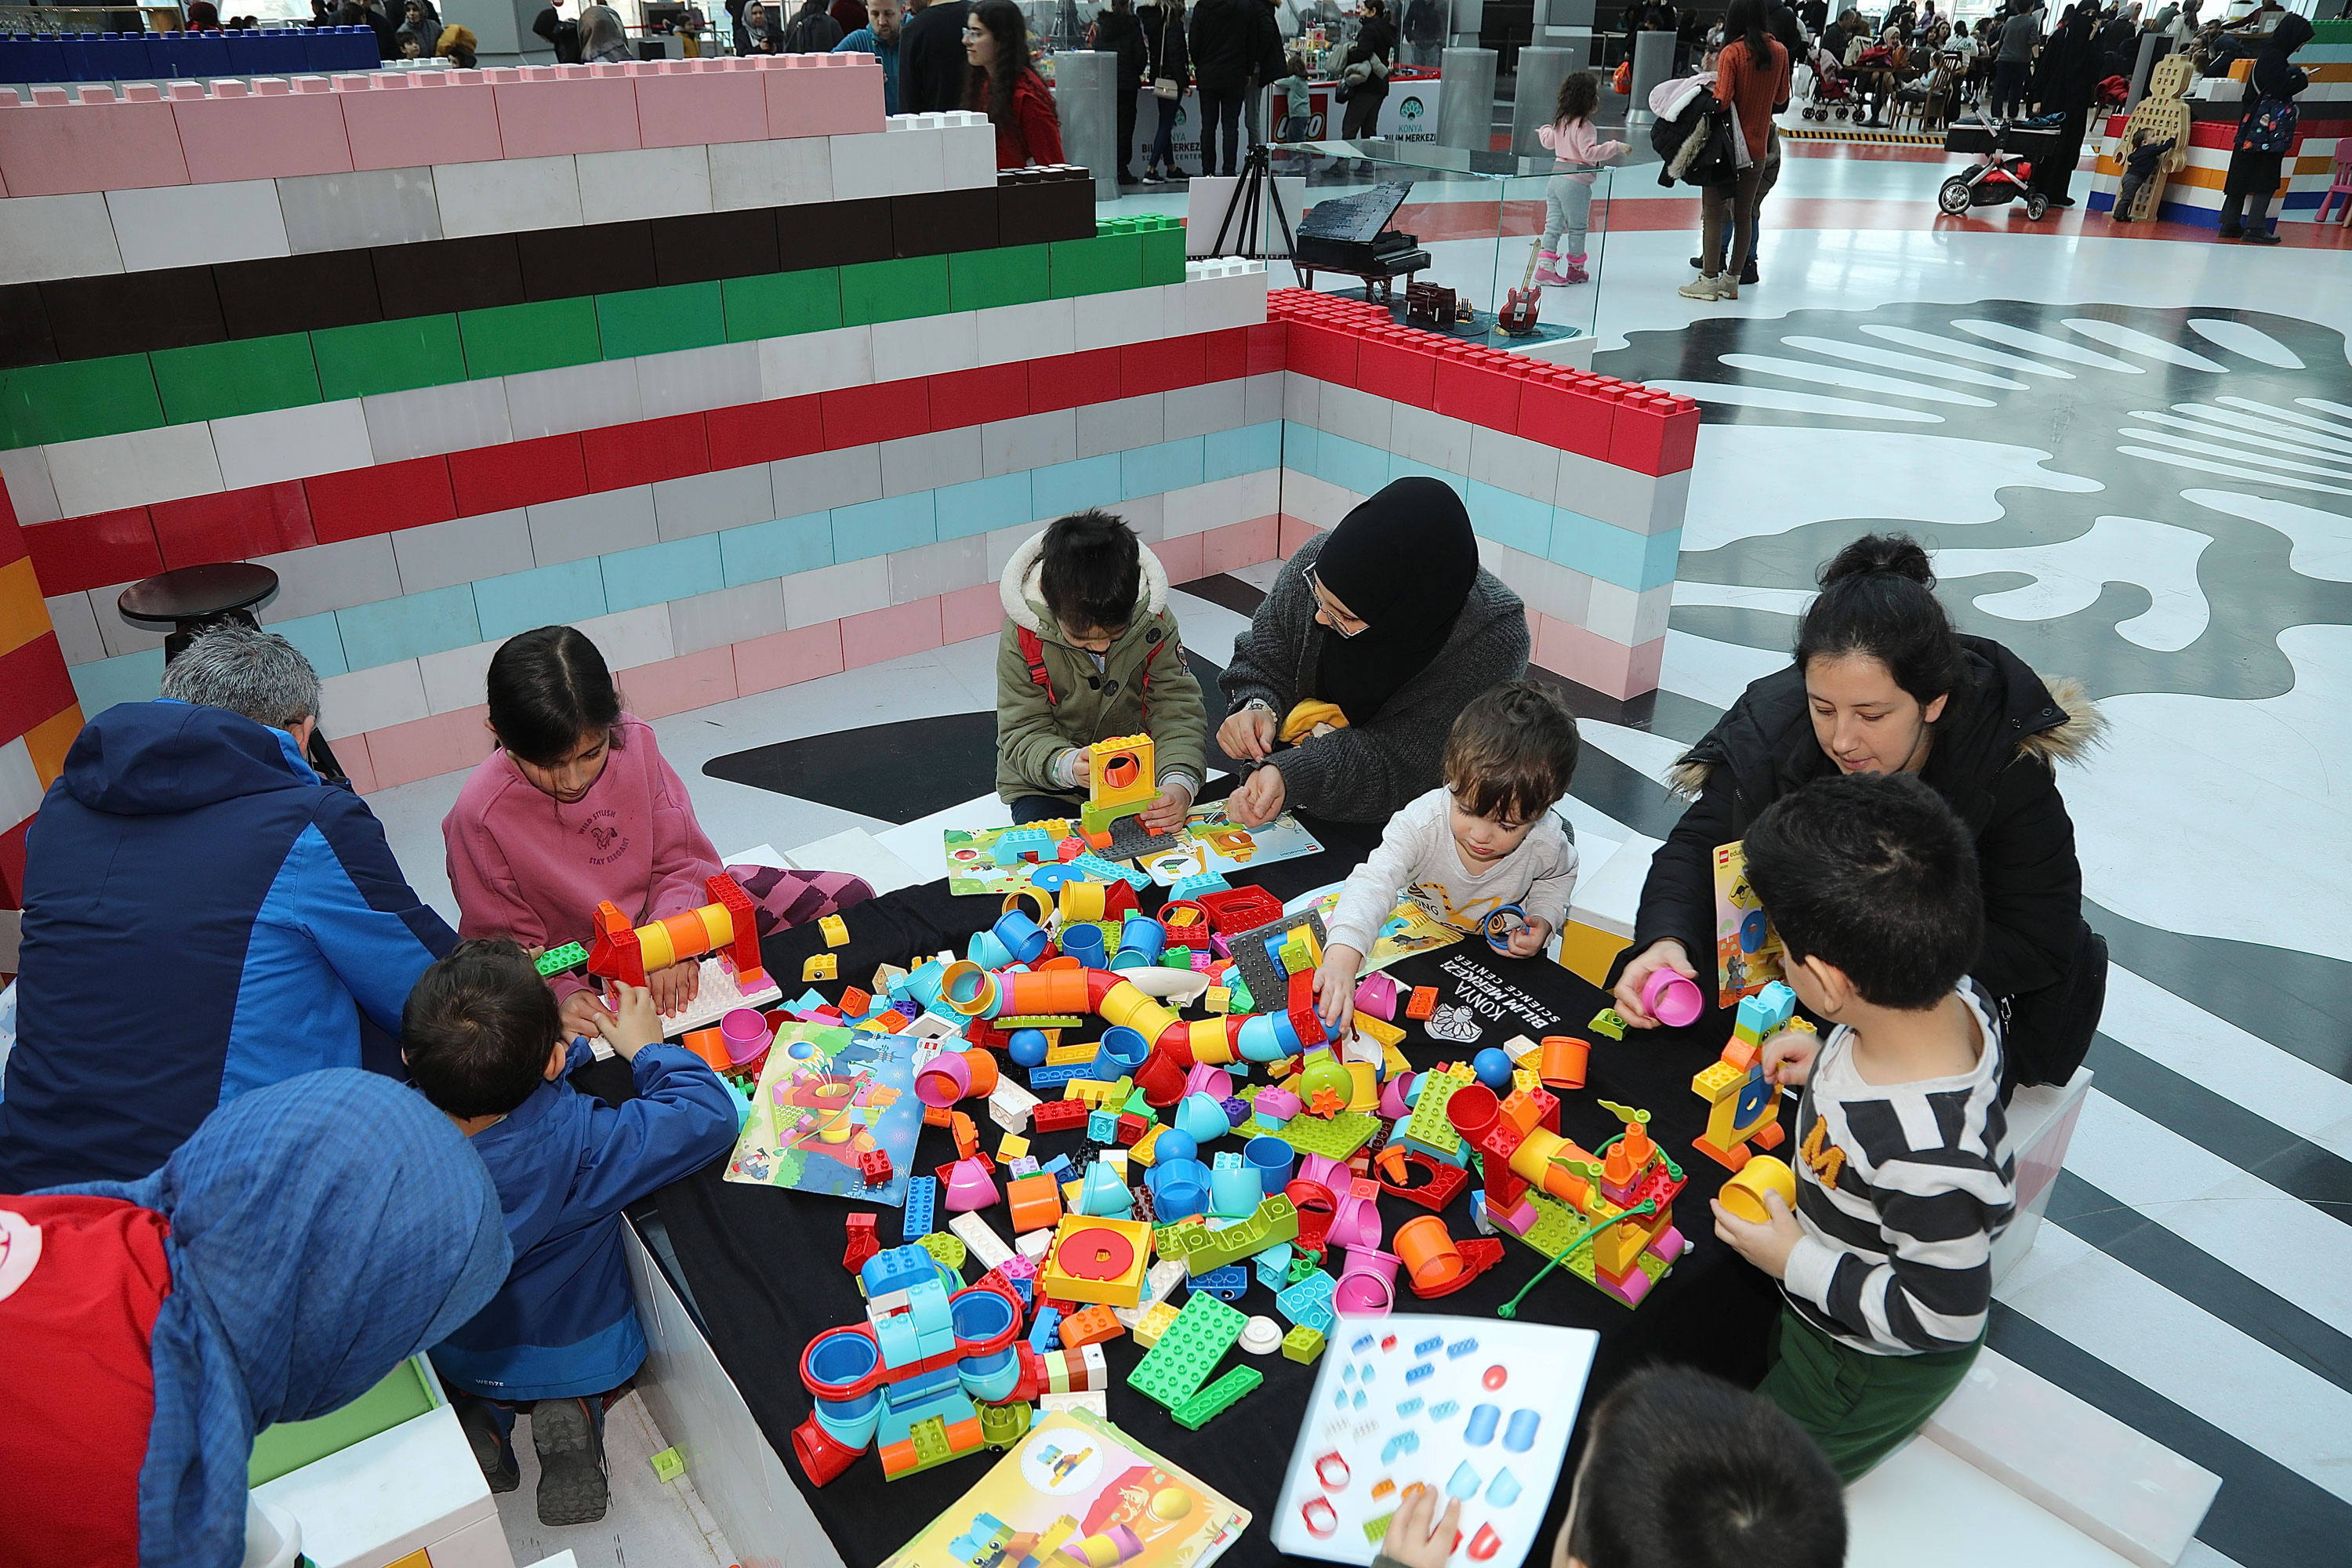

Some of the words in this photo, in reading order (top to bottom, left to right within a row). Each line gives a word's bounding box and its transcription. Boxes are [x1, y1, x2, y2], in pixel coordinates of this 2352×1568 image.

[1276, 114, 1323, 139] LO
[1174, 143, 1201, 152] ERKEZ
[577, 818, 593, 835] WILD
[593, 809, 616, 820] STYLISH
[589, 857, 604, 866] STAY
[607, 837, 630, 863] ELEGANT
[1454, 954, 1503, 984] CENTER
[1454, 981, 1507, 1022] KONYA
[1504, 985, 1561, 1022] SCIENCE
